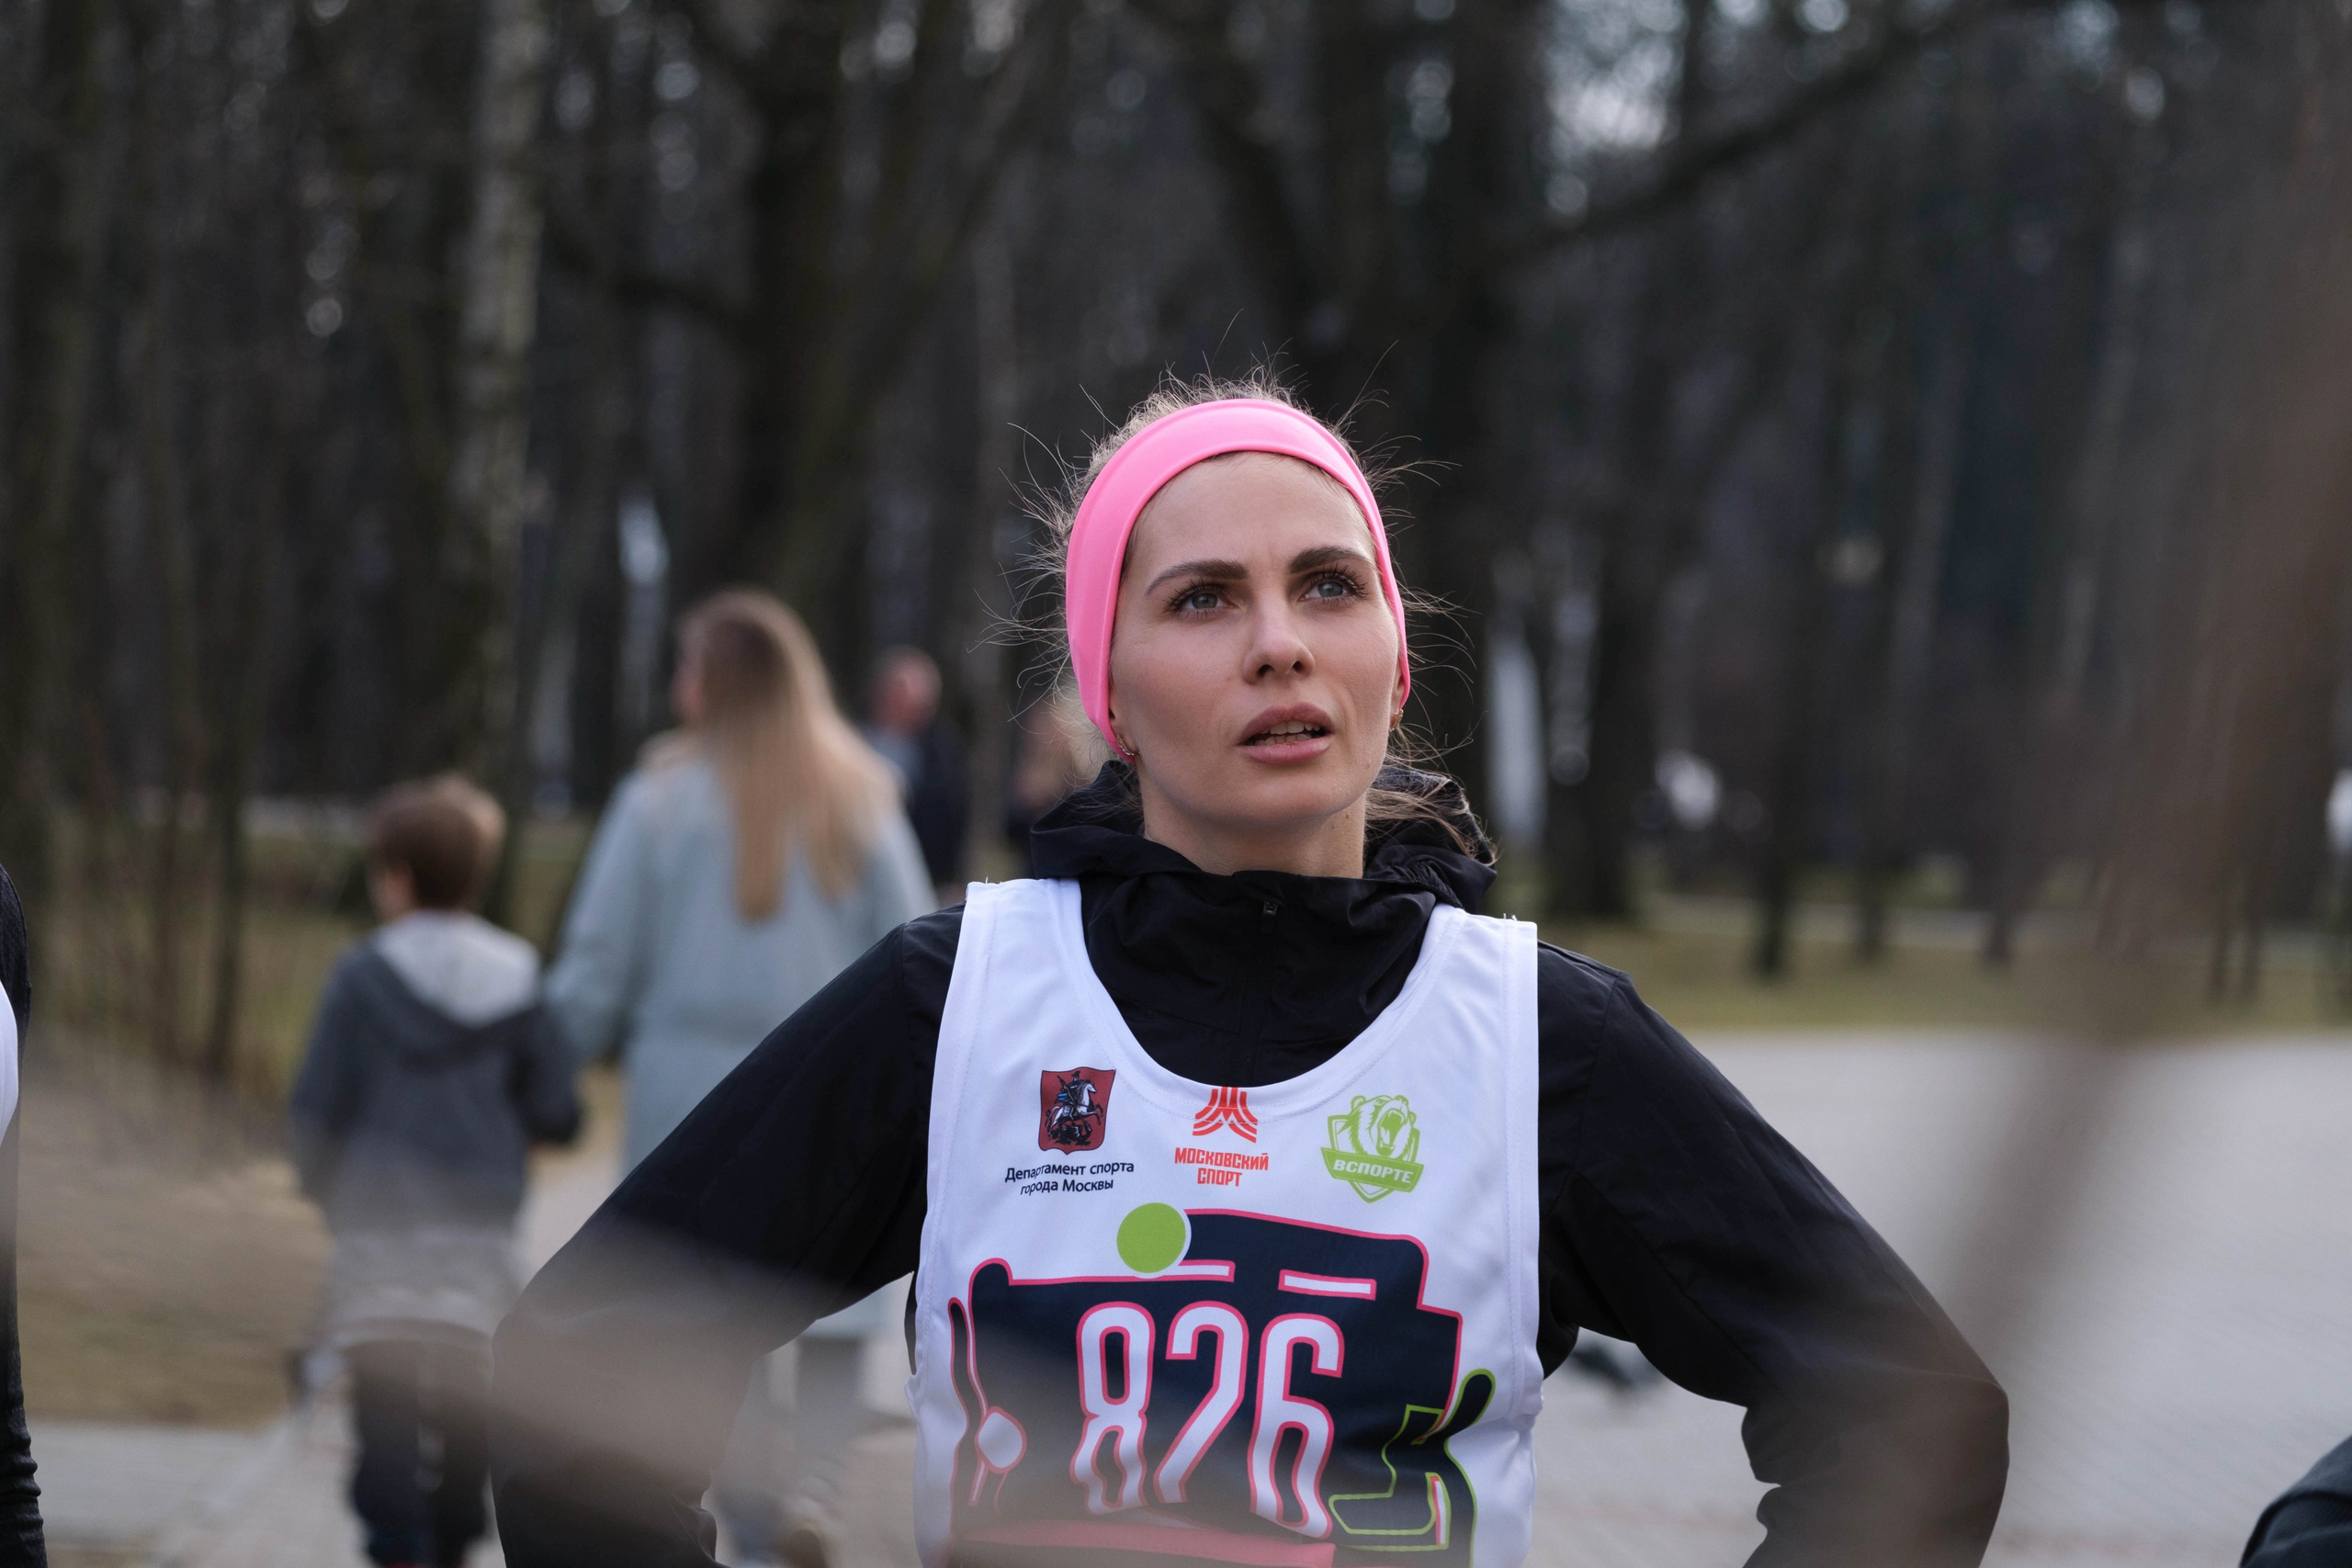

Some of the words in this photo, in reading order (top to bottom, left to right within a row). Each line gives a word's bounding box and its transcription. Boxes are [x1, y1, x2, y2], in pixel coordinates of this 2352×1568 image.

[1174, 1146, 1269, 1171] МОСКОВСКИЙ
[1005, 1164, 1086, 1183] Департамент
[1090, 1162, 1135, 1176] спорта
[1197, 1168, 1242, 1187] СПОРТ
[1333, 1158, 1414, 1184] ВСПОРТЕ
[1020, 1180, 1058, 1196] города
[1062, 1179, 1114, 1192] Москвы
[1073, 1302, 1344, 1539] 826
